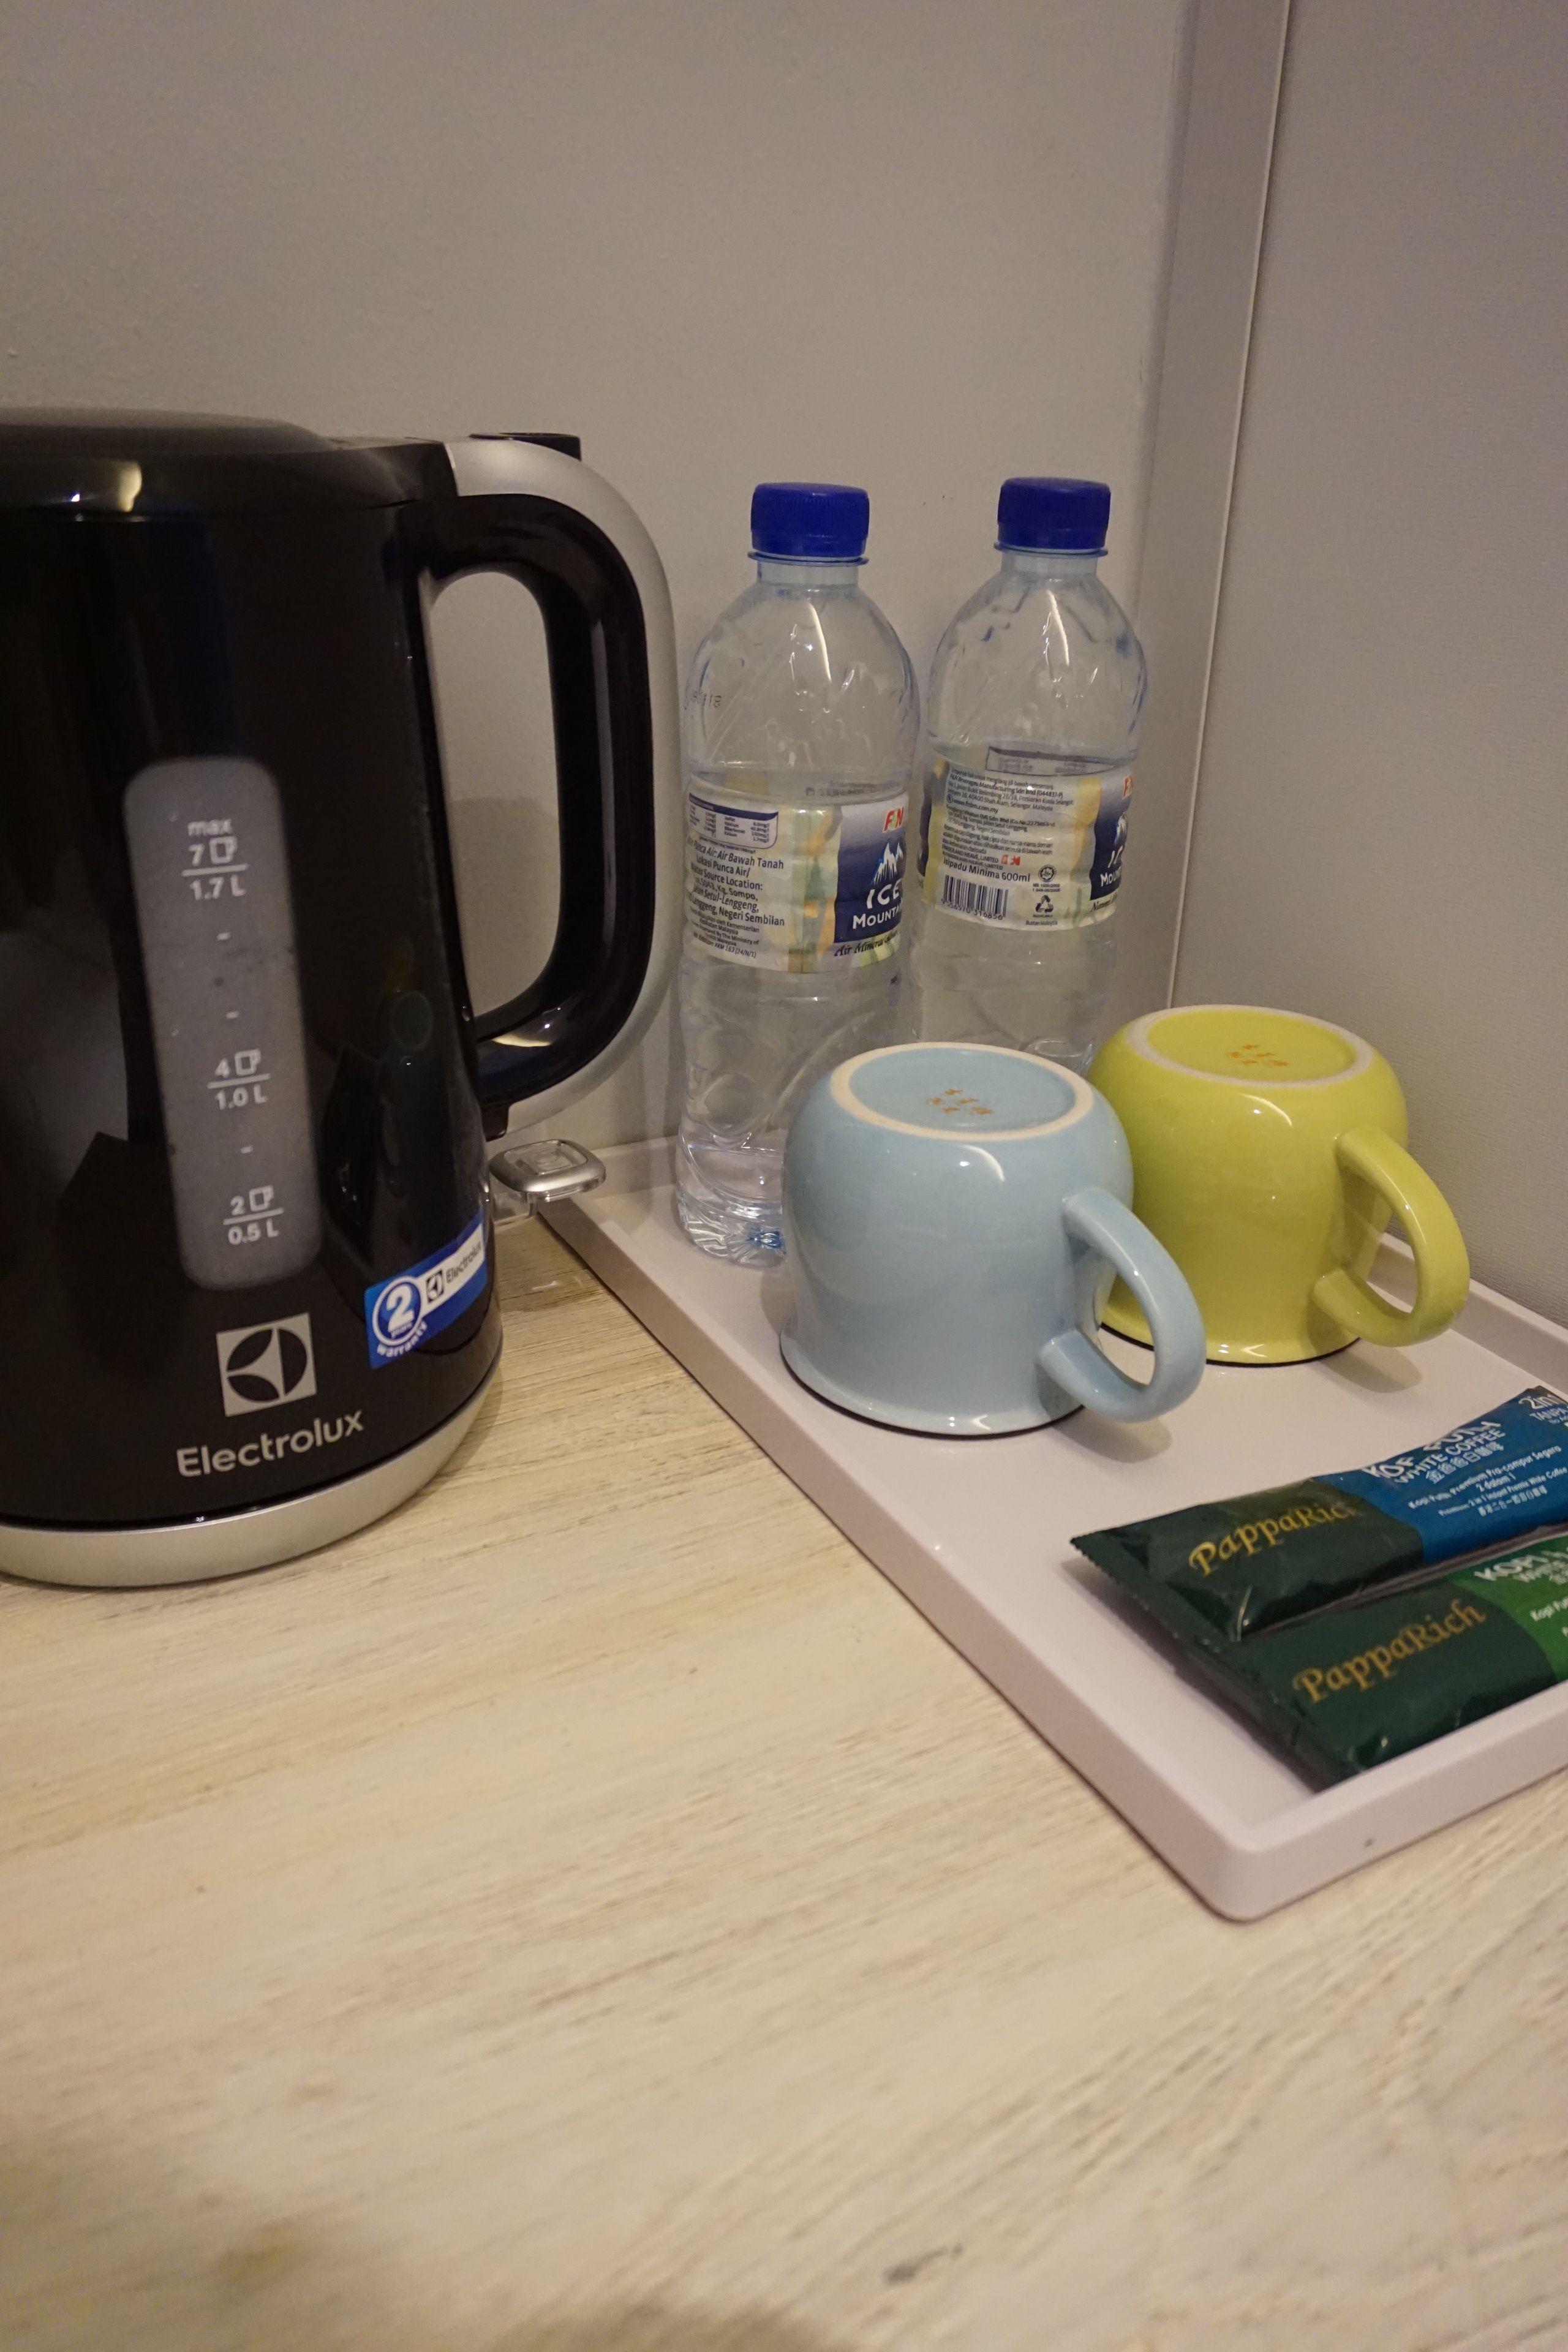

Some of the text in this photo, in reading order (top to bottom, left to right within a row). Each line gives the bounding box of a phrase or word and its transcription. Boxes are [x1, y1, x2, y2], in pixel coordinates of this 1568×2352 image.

[187, 818, 232, 837] max
[187, 843, 206, 867] 7
[717, 850, 728, 861] Air
[728, 853, 755, 867] Bawah
[757, 858, 784, 869] Tanah
[703, 868, 725, 884] Source
[726, 876, 763, 891] Location:
[712, 860, 734, 875] Punca
[736, 866, 751, 878] Air/
[944, 857, 1030, 882] Isipadu Minima 600ml
[189, 873, 247, 901] 1.7 L
[718, 907, 744, 921] Negeri
[744, 911, 785, 927] Sembilan
[214, 1057, 230, 1078] 4
[214, 1083, 268, 1110] 1.0 L
[230, 1195, 246, 1216] 2
[227, 1217, 280, 1246] 0.5 L
[385, 1283, 415, 1333] 2
[176, 1409, 365, 1479] Electrolux
[1445, 1427, 1506, 1456] COFFEE
[1292, 1597, 1487, 1704] PappaRich
